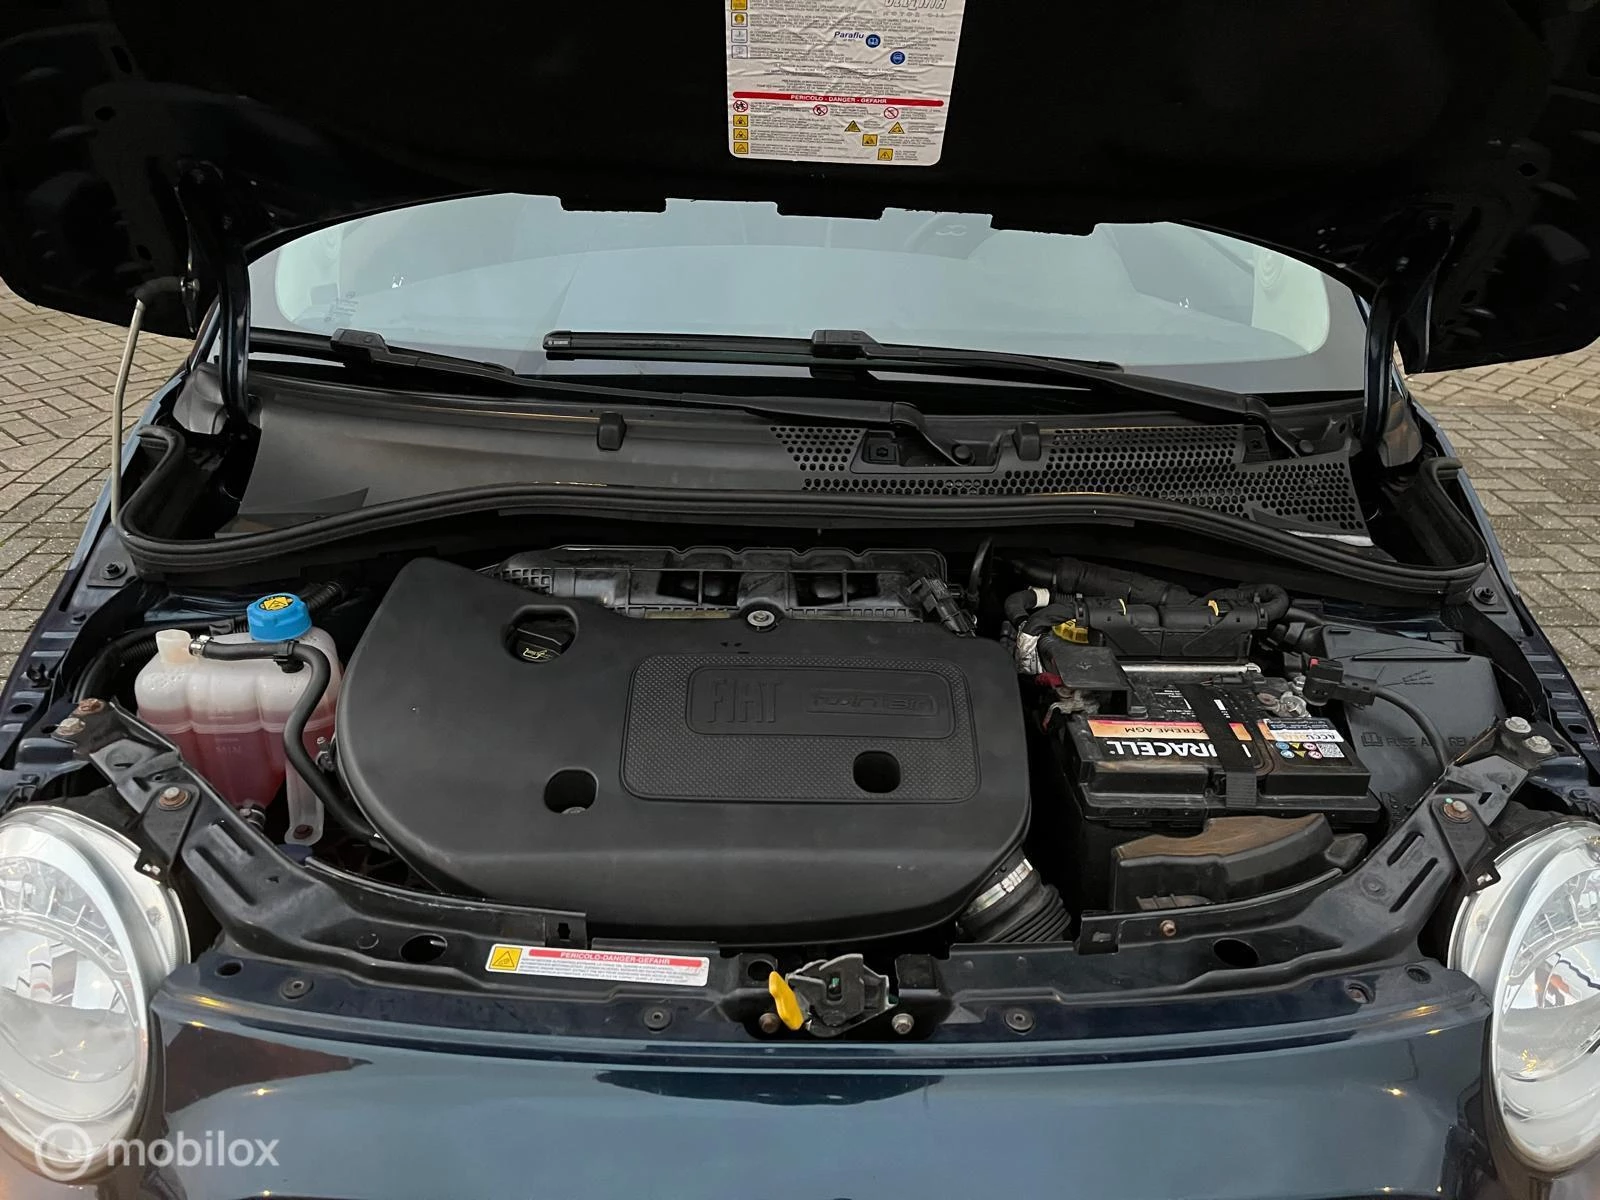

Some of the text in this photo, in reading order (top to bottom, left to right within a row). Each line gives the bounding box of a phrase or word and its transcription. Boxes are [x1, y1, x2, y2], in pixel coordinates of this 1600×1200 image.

[834, 31, 865, 40] Paraflu
[706, 677, 783, 724] FIAT
[1156, 726, 1206, 734] XTREME
[1386, 736, 1417, 747] FUSE
[1107, 740, 1251, 758] RACELL
